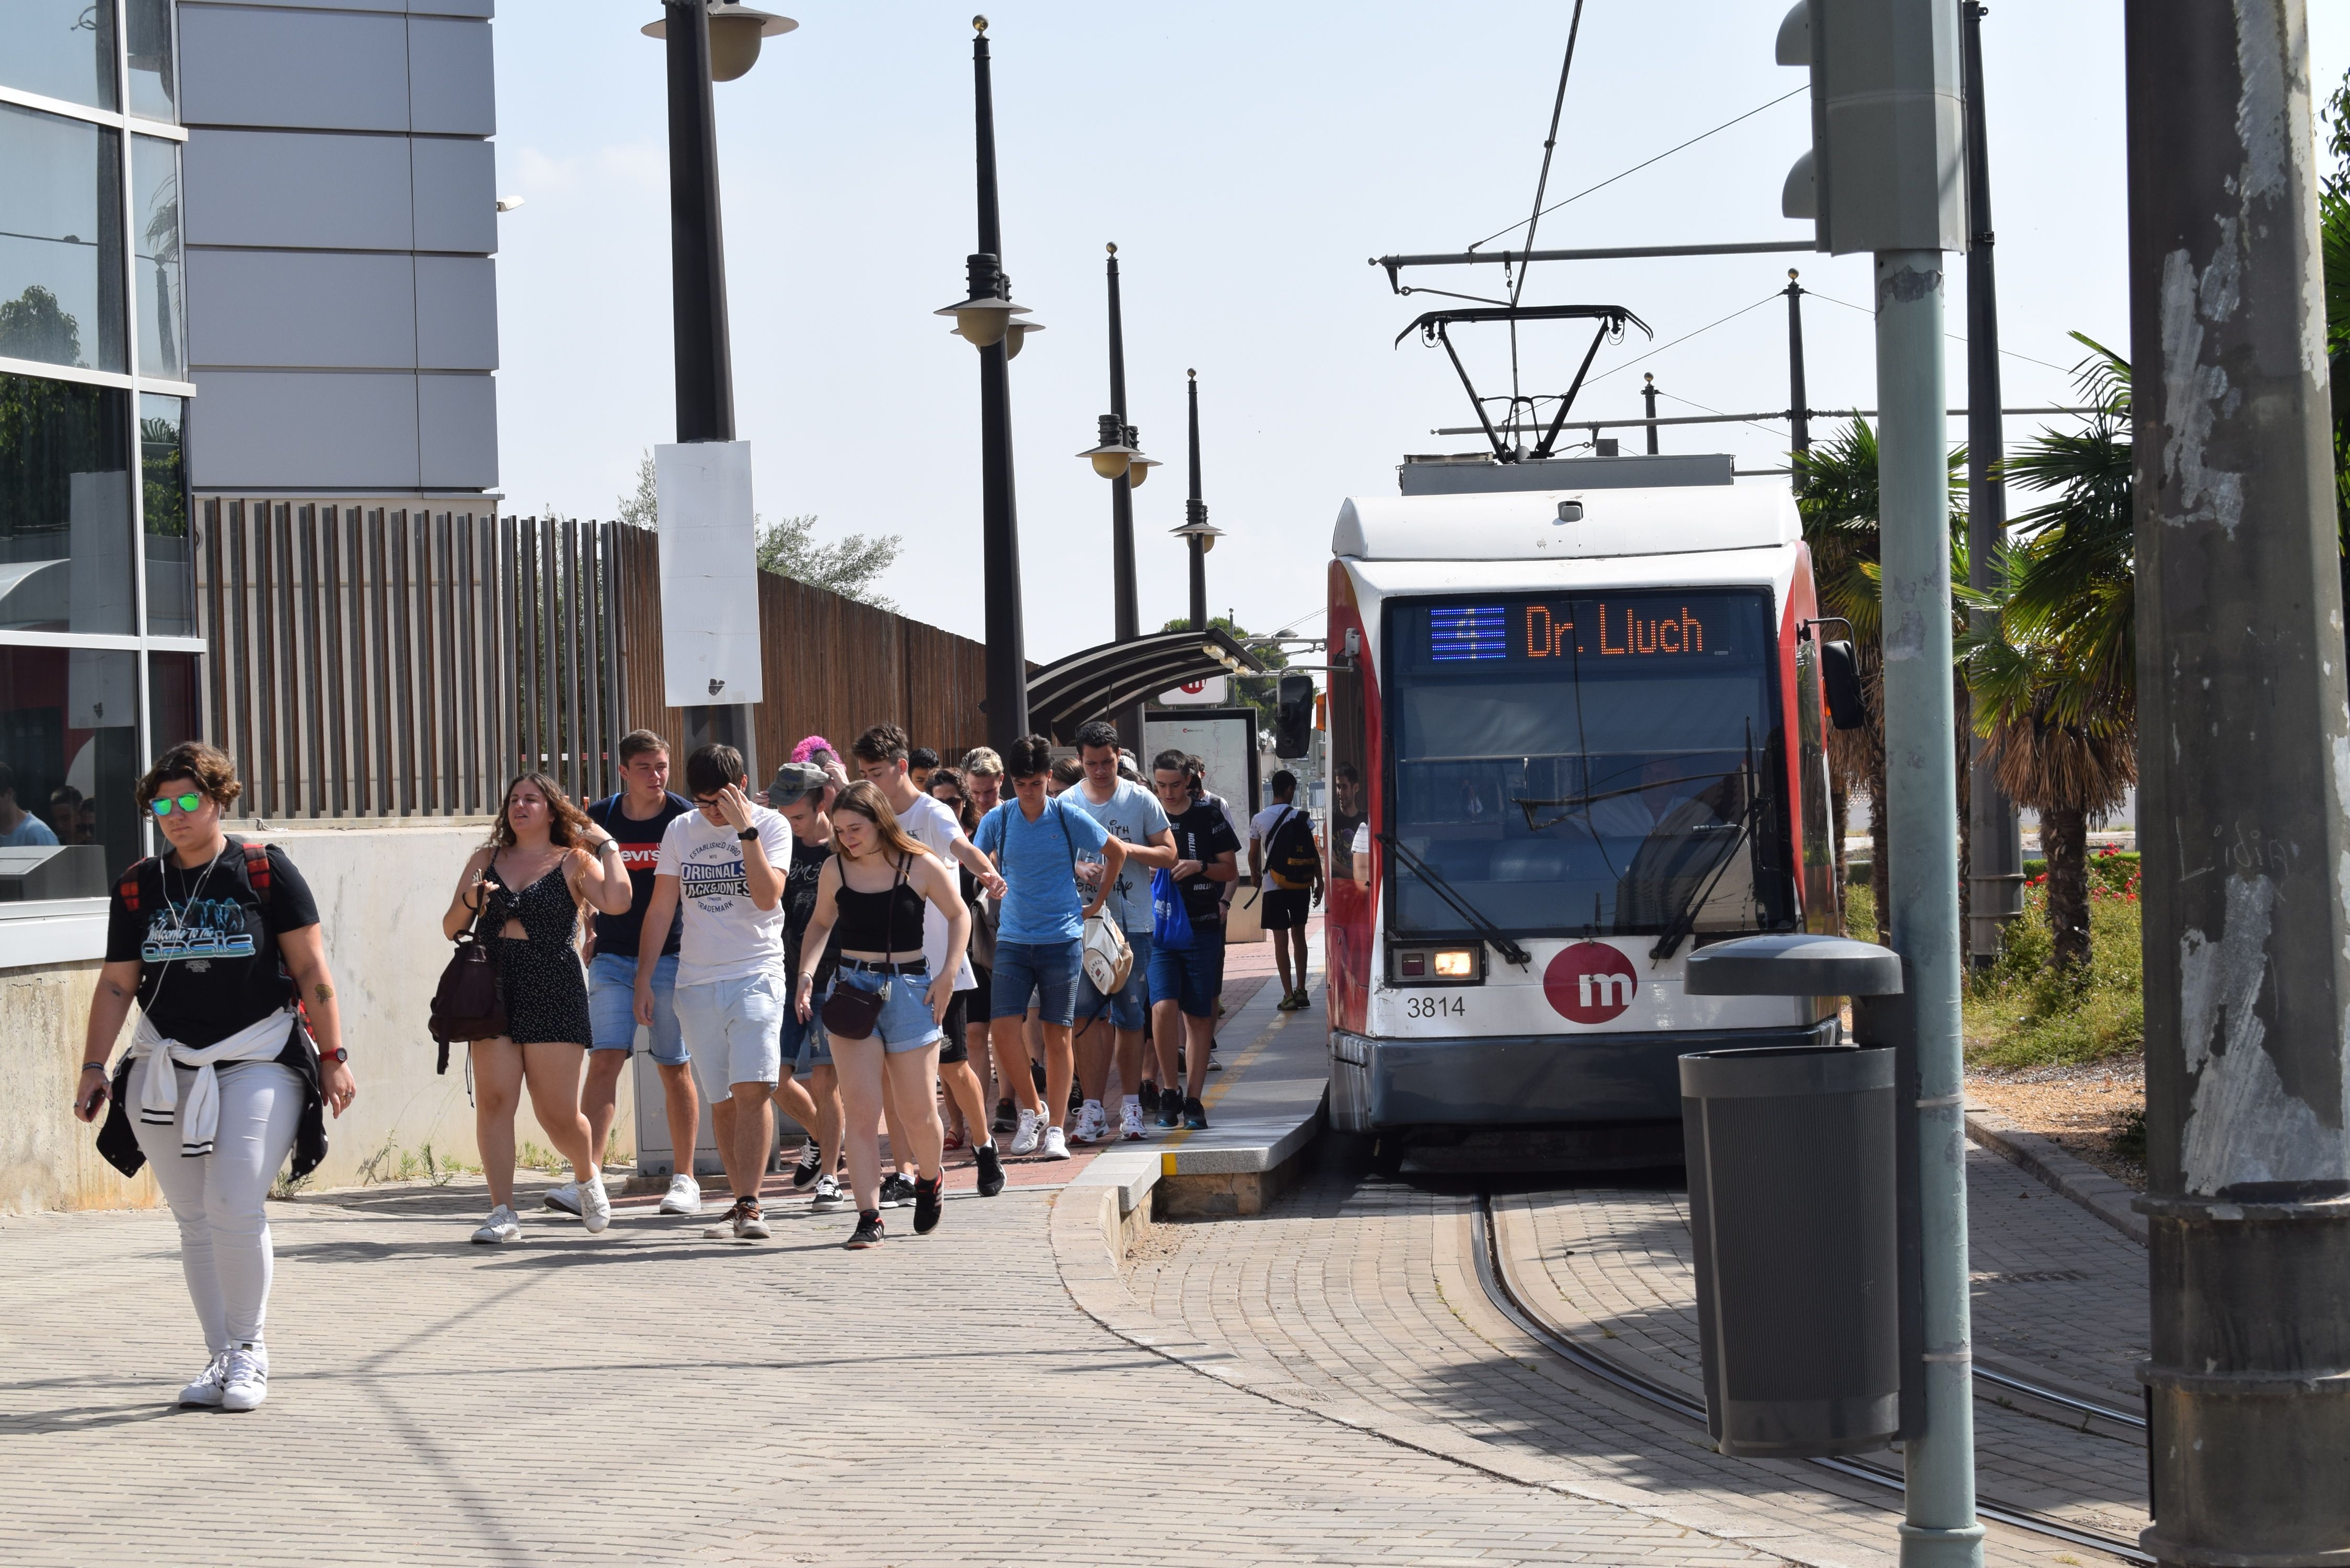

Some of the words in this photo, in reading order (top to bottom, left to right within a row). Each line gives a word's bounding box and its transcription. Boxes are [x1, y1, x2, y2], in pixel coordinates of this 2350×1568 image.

[1456, 608, 1480, 659] 4
[1526, 606, 1583, 657] Dr.
[1599, 604, 1702, 654] Lluch
[689, 841, 726, 860] ESTABLISHED
[726, 844, 742, 857] 1990
[1188, 832, 1196, 860] HOLLIST
[681, 863, 746, 880] ORIGINALS
[684, 882, 752, 898] JACK&JONES
[697, 900, 734, 914] TRADEMARK
[1407, 996, 1466, 1018] 3814
